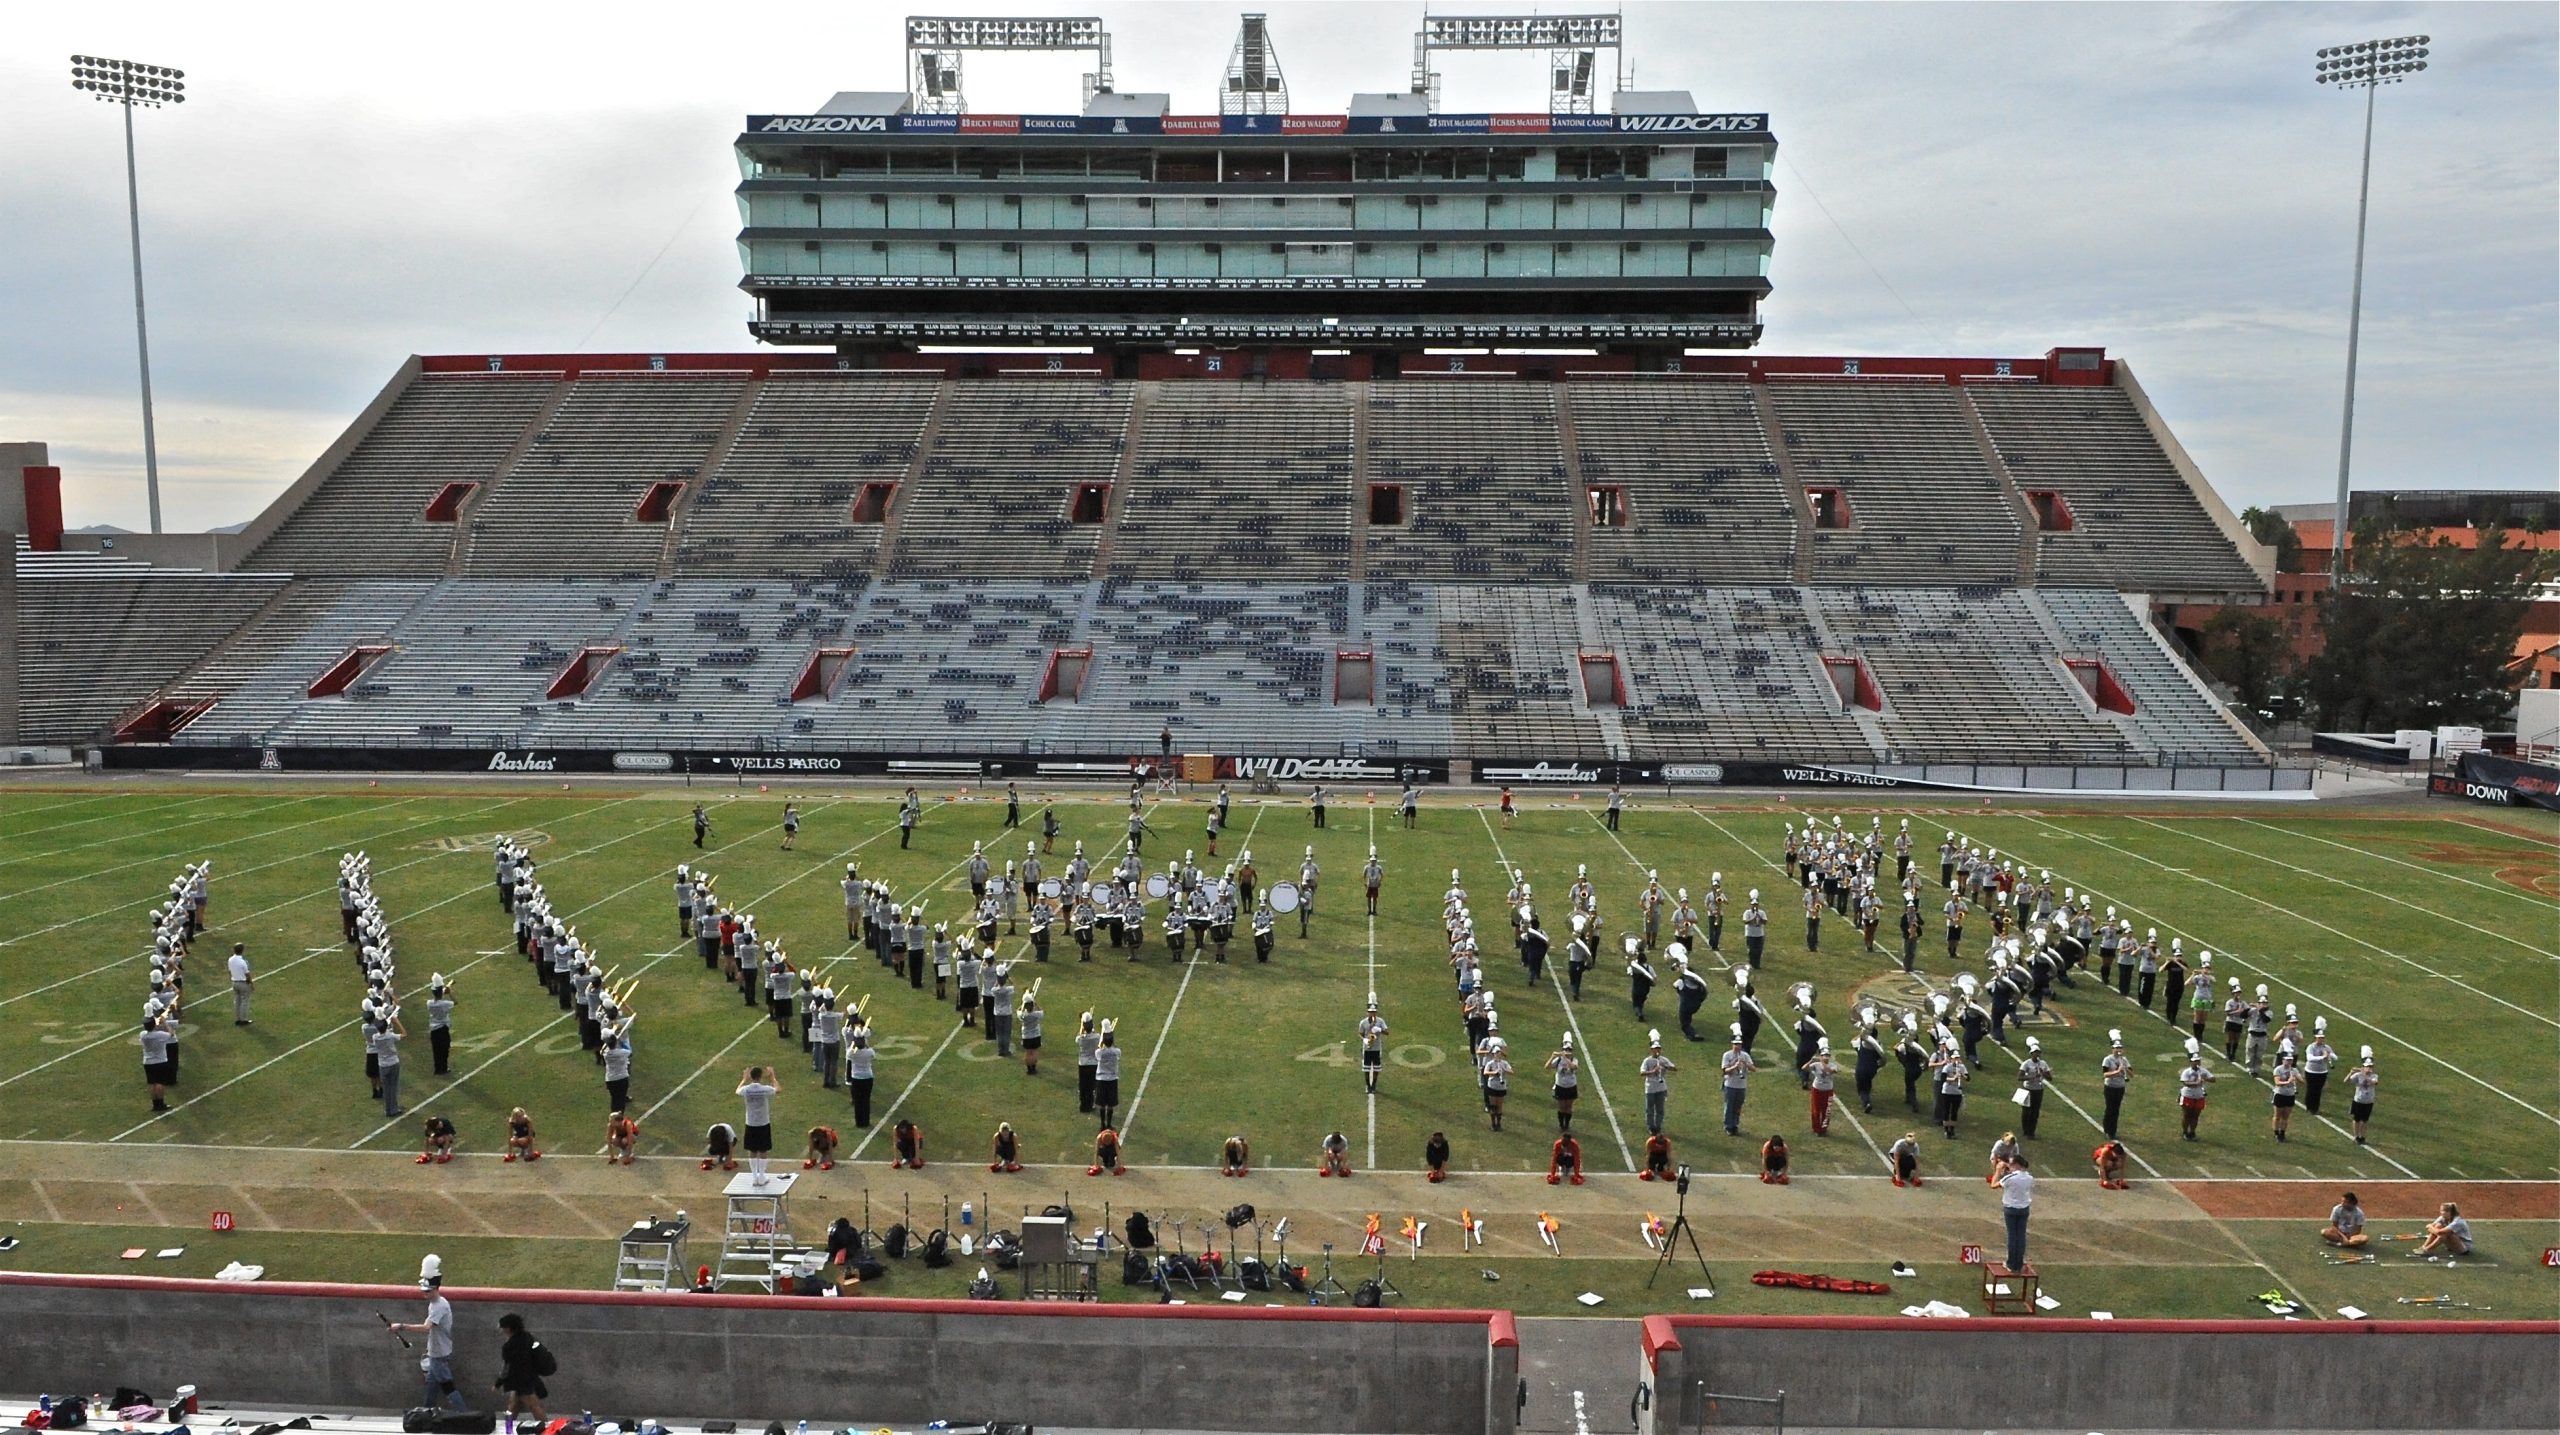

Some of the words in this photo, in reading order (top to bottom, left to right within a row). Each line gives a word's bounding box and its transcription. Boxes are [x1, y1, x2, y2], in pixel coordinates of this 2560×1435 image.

[761, 117, 887, 132] ARIZONA
[903, 118, 912, 126] 22
[912, 119, 926, 127] ART
[927, 119, 957, 127] LUPPINO
[970, 120, 992, 128] RICKY
[993, 120, 1019, 128] HUNLEY
[1031, 120, 1055, 128] CHUCK
[1056, 120, 1076, 128] CECIL
[1168, 121, 1198, 129] DARRYLL
[1291, 120, 1306, 128] ROB
[1307, 120, 1341, 128] WALDROP
[1438, 119, 1454, 127] STEVE
[1454, 119, 1489, 127] McLAUGHLIN
[1490, 118, 1496, 127] 11
[1496, 119, 1514, 127] CHRIS
[1517, 118, 1550, 127] McALISTER
[1557, 119, 1586, 127] ANTOINE
[1587, 119, 1610, 127] CASON
[1619, 116, 1761, 131] WILDCATS
[490, 362, 501, 372] 17
[652, 361, 663, 371] 18
[838, 361, 849, 370] 19
[1047, 361, 1061, 370] 20
[1208, 361, 1220, 370] 21
[1450, 362, 1464, 372] 22
[1667, 363, 1680, 373] 23
[1844, 365, 1857, 374] 24
[1996, 367, 2010, 376] 25
[102, 539, 113, 548] 16
[488, 752, 557, 771] Bashas'
[730, 758, 785, 769] WELLS
[788, 758, 841, 769] FARGO
[1680, 769, 1717, 777] CASINOS
[1783, 769, 1839, 782] WELLS
[2433, 779, 2465, 795] BEAR
[2466, 783, 2508, 803] DOWN
[1295, 1042, 1447, 1069] 40
[213, 1213, 230, 1229] 40
[755, 1218, 771, 1233] 50
[1368, 1235, 1381, 1252] 40
[1964, 1247, 1979, 1263] 30
